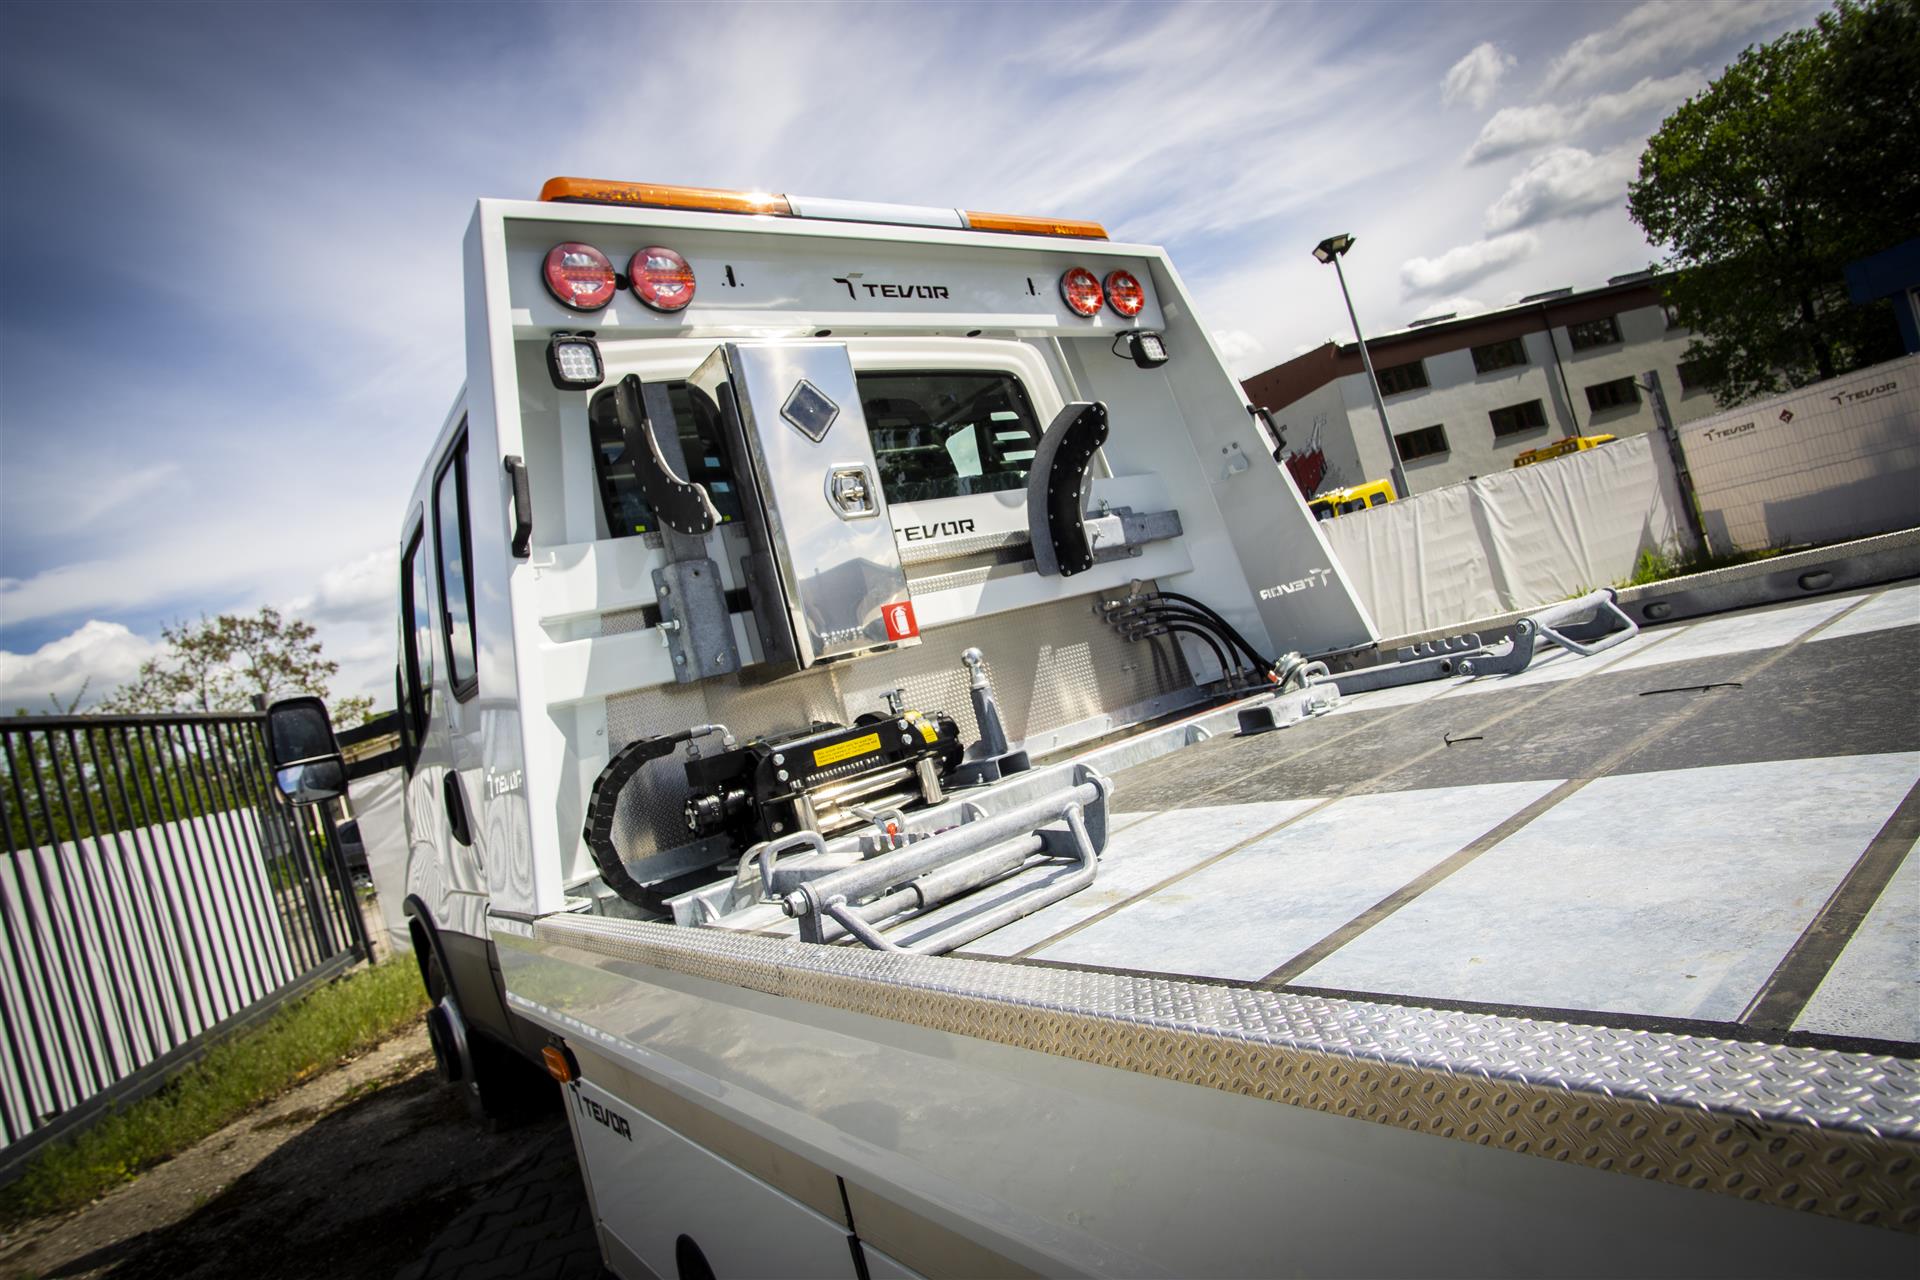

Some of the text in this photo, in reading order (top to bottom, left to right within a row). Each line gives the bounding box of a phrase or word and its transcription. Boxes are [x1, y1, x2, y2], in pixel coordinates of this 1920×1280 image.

[862, 284, 949, 299] TEVOR
[1845, 382, 1897, 402] TEVOR
[1715, 422, 1755, 438] TEVOR
[582, 1095, 632, 1142] TEVOR
